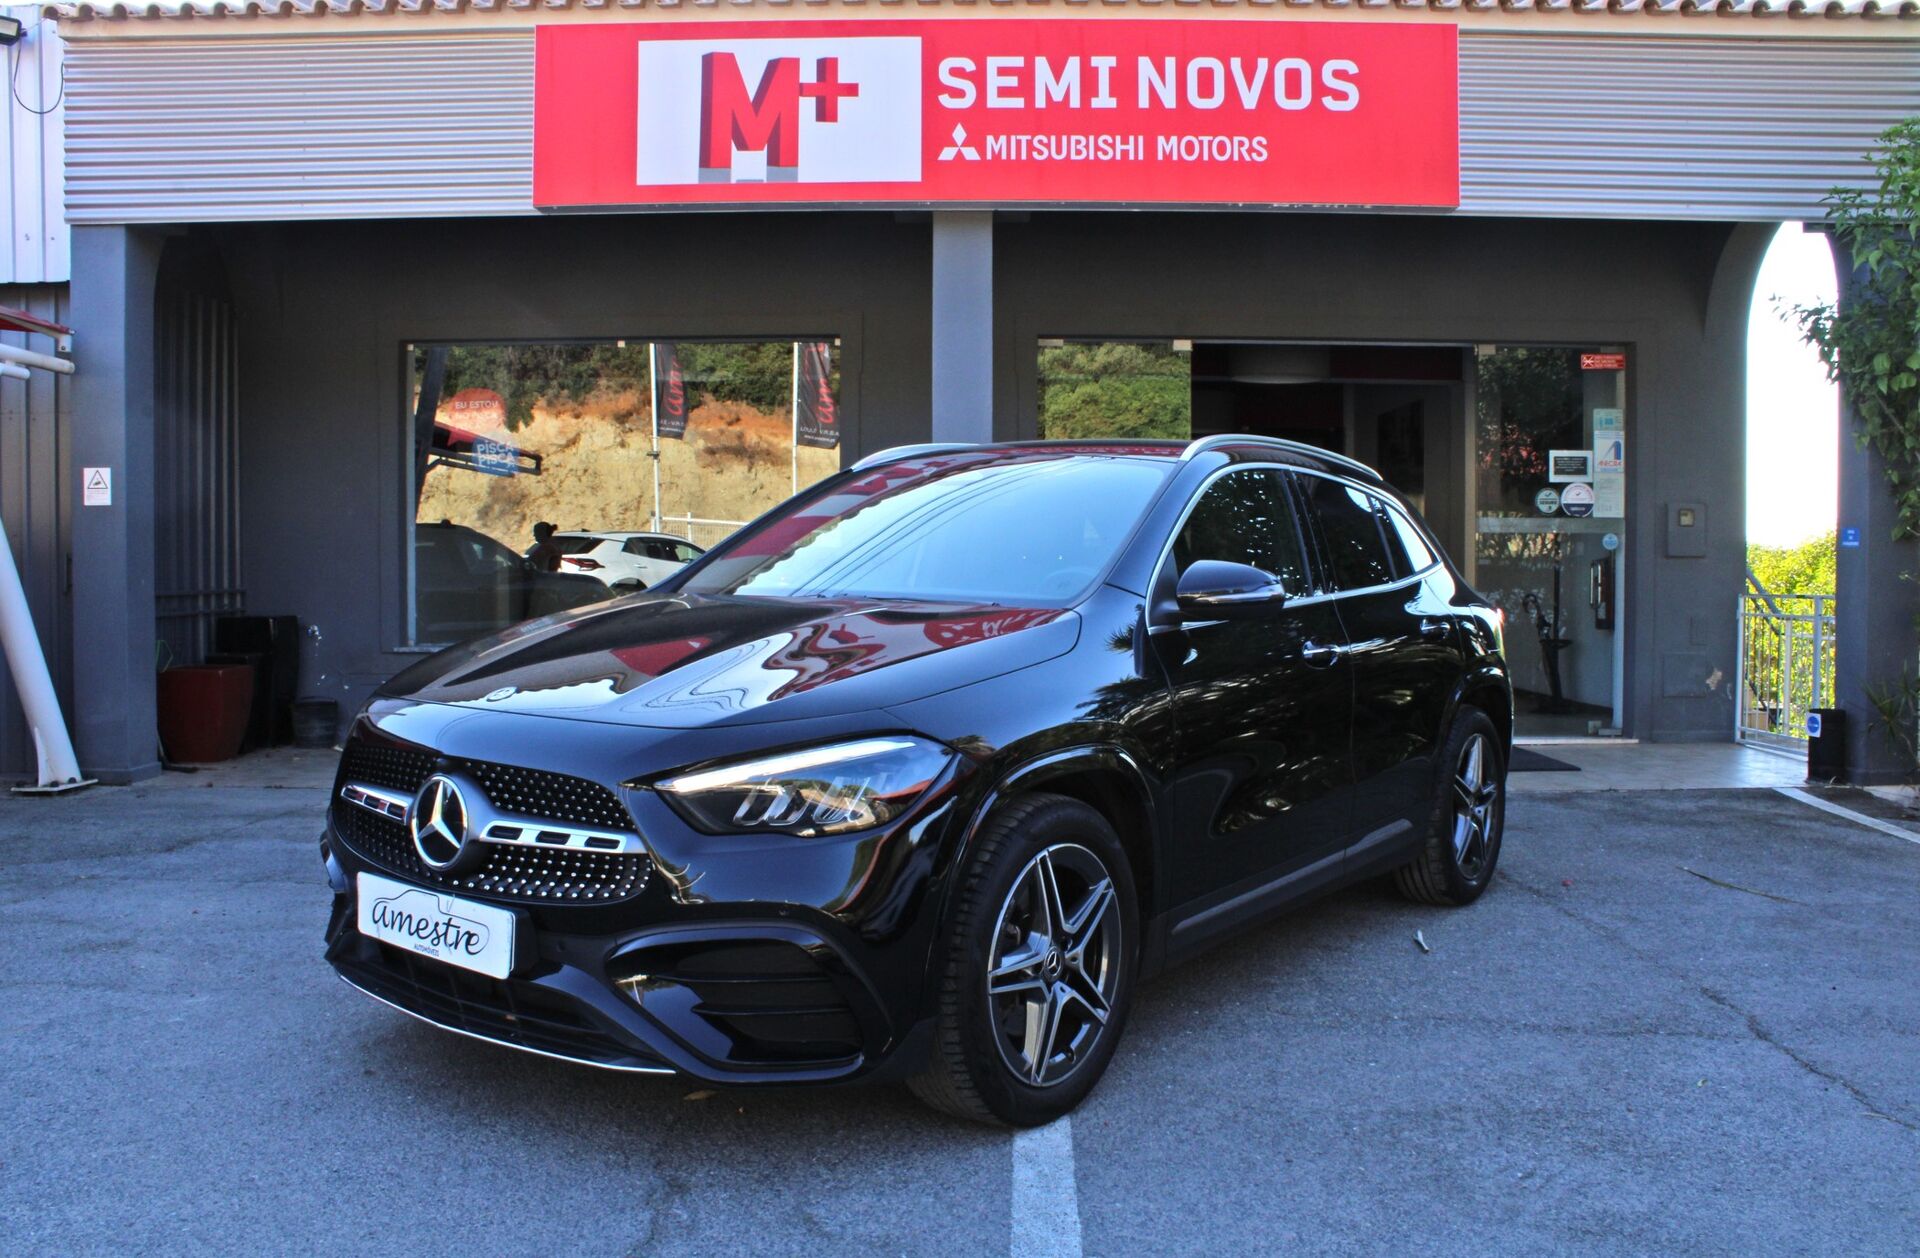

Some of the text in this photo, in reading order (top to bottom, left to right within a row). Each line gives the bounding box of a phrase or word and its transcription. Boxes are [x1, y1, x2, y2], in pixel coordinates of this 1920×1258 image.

[937, 55, 1360, 112] SEMI NOVOS
[986, 134, 1268, 162] MITSUBISHI MOTORS
[372, 900, 481, 956] amestre
